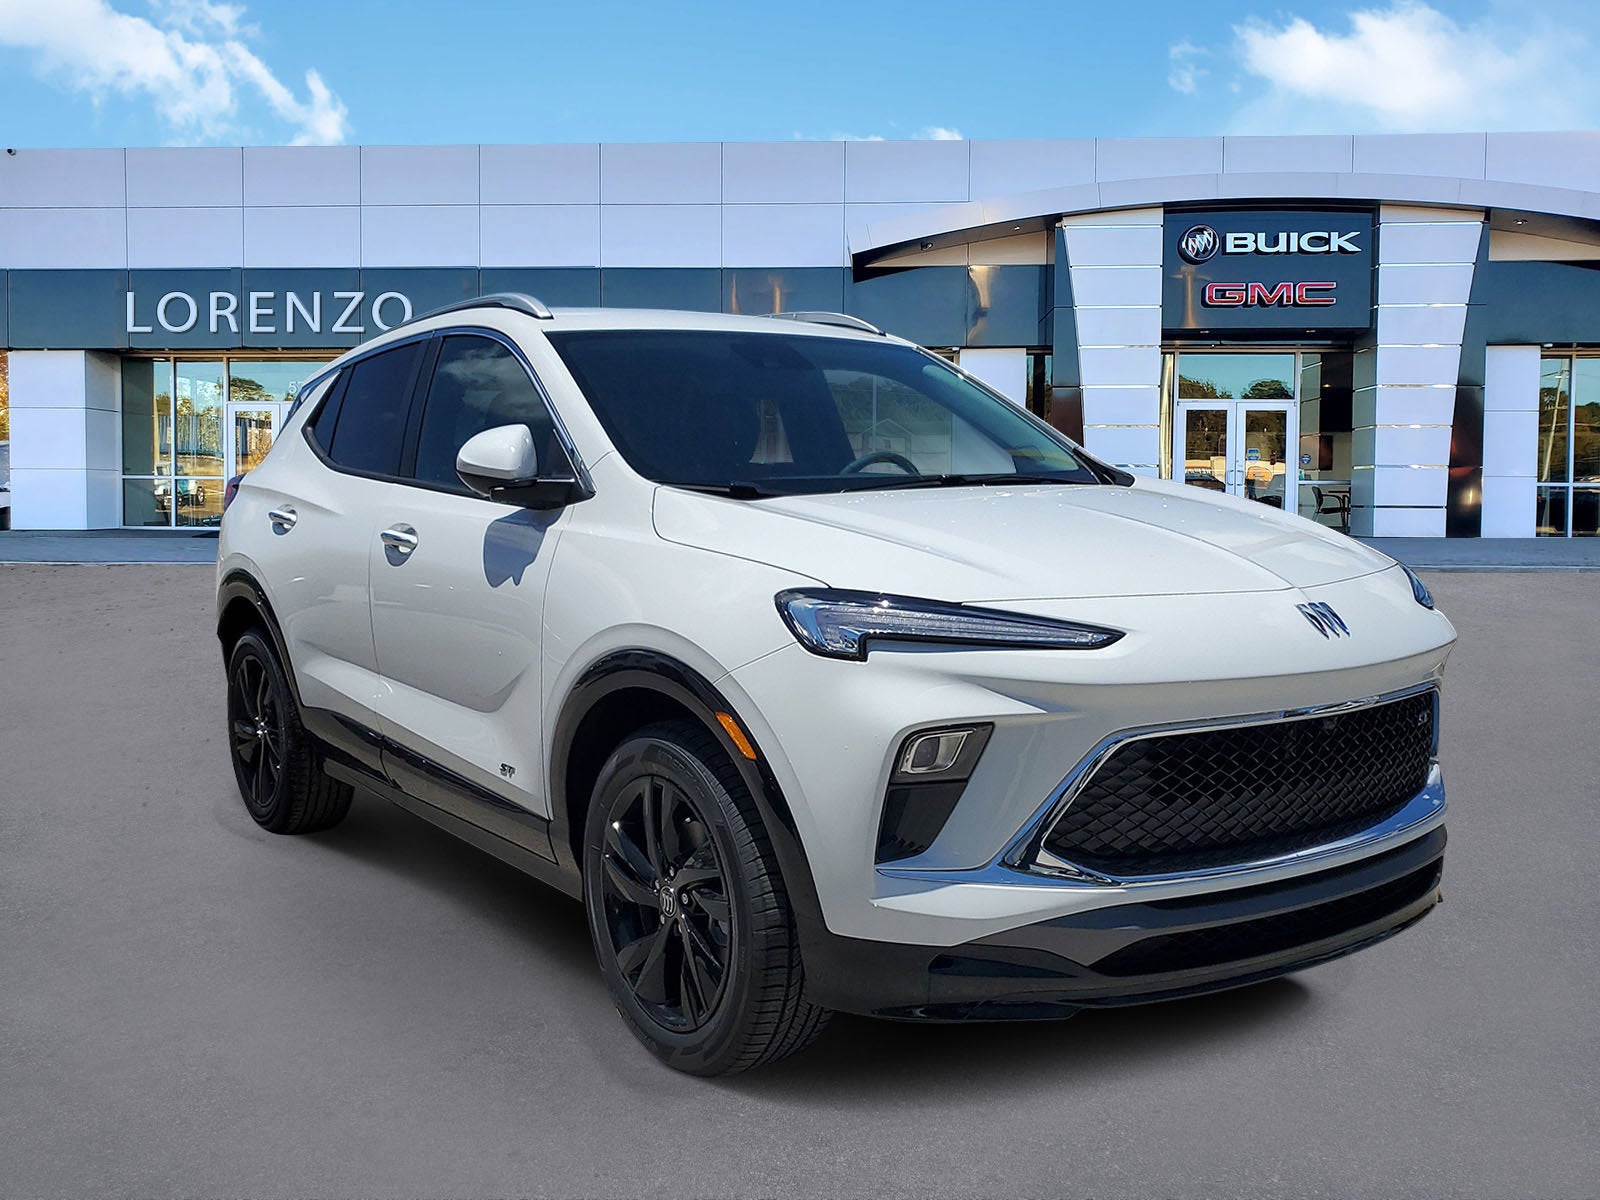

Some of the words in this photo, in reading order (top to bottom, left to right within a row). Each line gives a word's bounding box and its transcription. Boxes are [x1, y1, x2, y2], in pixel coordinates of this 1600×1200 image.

[1224, 231, 1362, 254] BUICK
[1204, 281, 1337, 306] GMC
[126, 291, 413, 334] LORENZO
